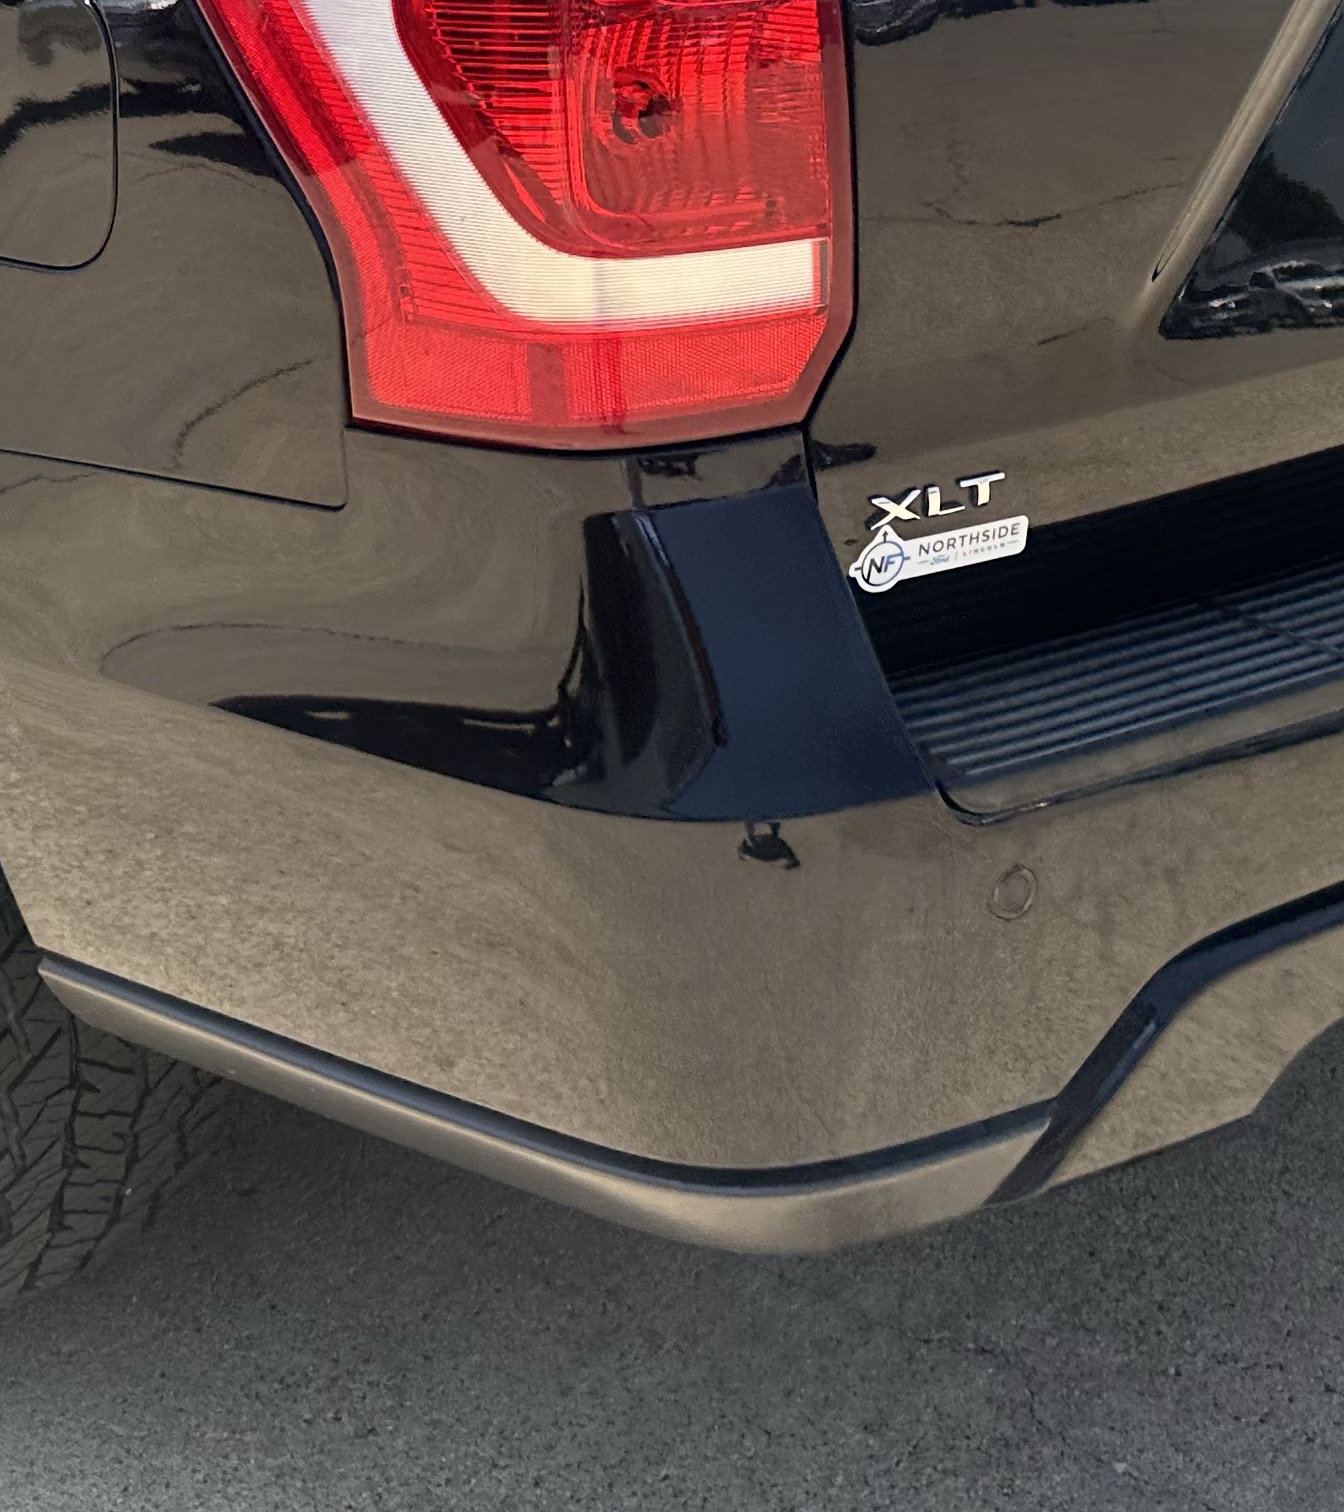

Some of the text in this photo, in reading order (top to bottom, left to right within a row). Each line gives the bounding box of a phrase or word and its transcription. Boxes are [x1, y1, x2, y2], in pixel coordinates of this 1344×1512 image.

[868, 471, 1006, 531] XLT
[918, 522, 1021, 557] NORTHSIDE
[866, 552, 903, 583] NF
